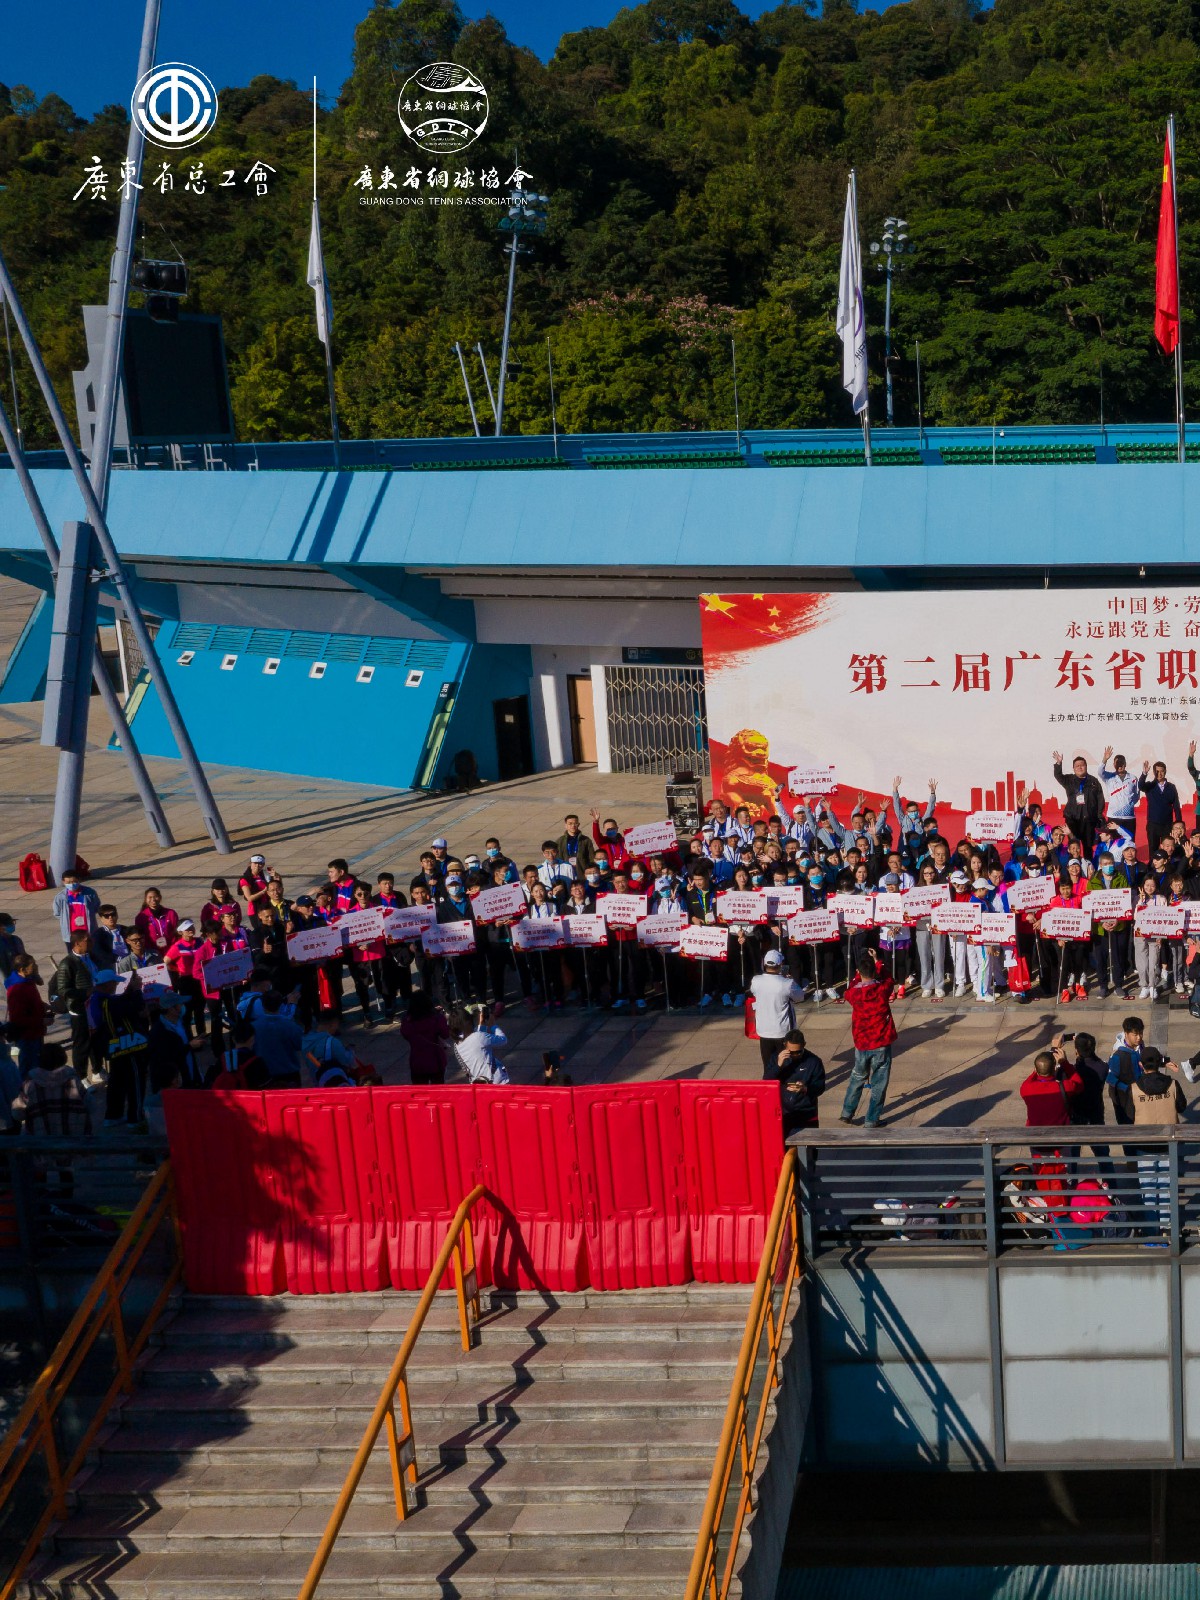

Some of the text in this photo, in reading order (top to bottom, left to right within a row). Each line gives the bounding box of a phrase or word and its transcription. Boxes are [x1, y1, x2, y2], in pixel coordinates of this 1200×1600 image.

[1065, 620, 1171, 640] 永远跟党走
[108, 1032, 148, 1054] FILA
